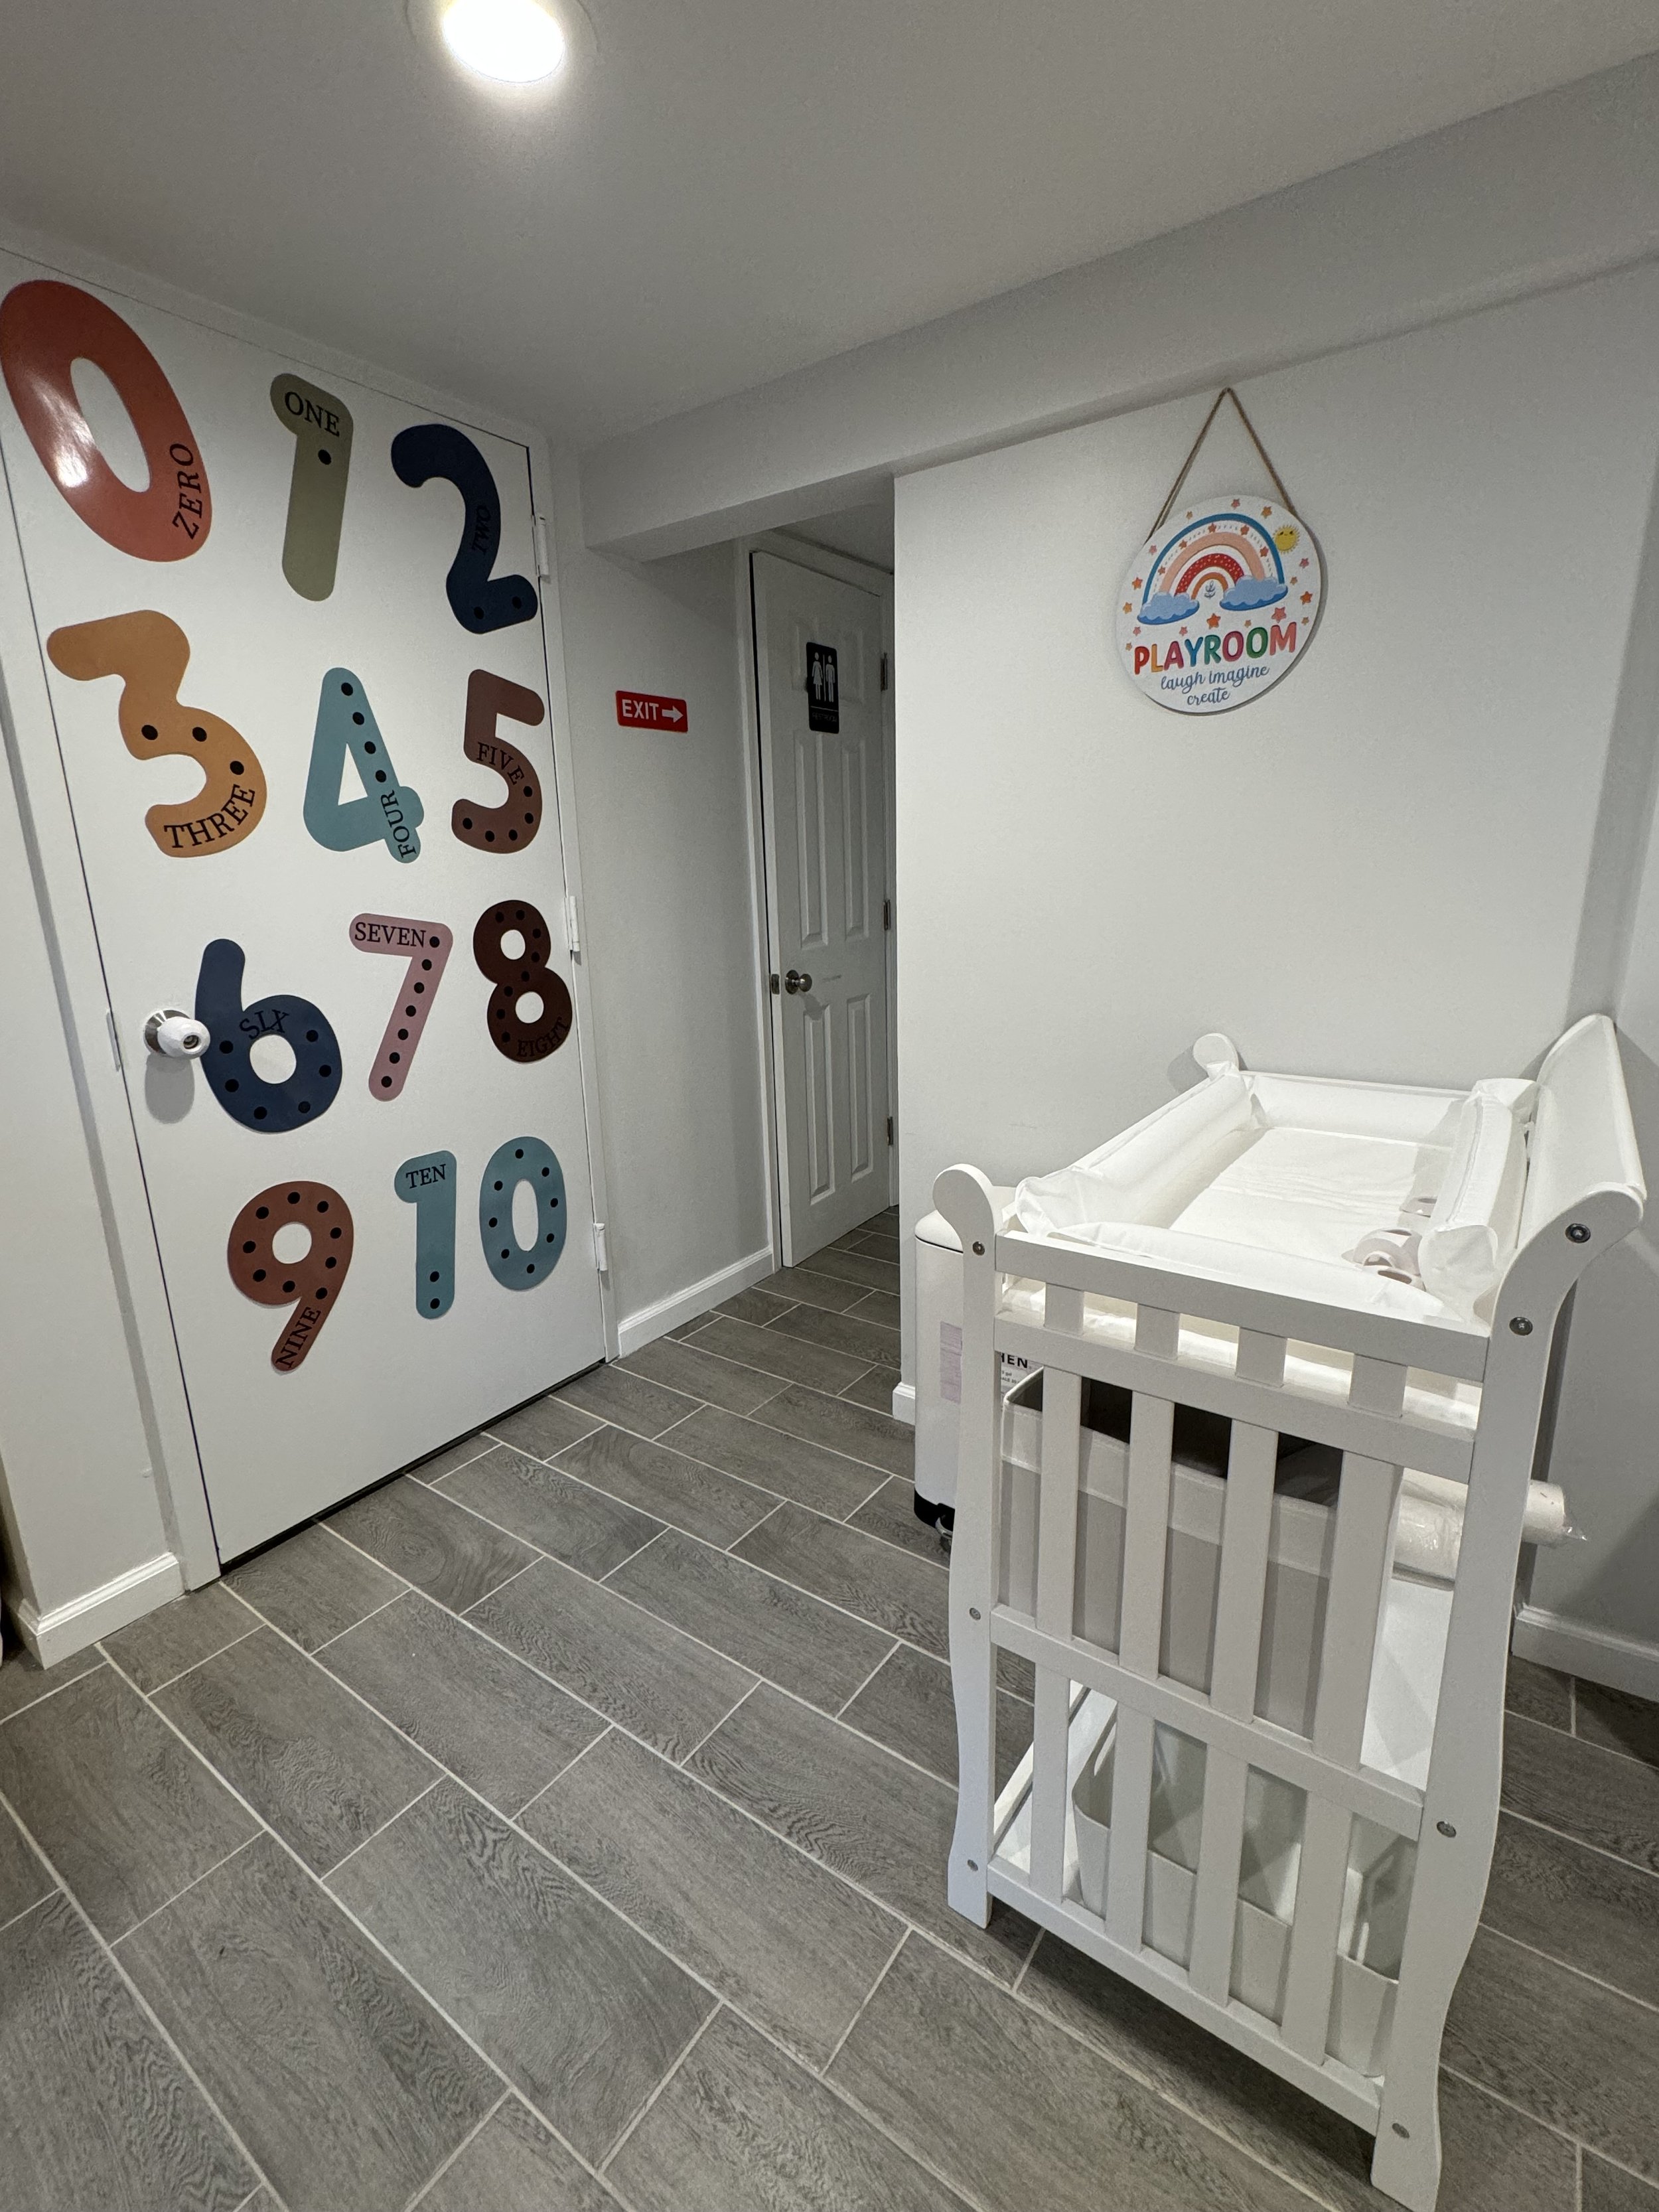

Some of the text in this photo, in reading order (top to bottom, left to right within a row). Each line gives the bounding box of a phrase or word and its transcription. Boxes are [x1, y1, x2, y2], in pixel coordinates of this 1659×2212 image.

[0, 280, 212, 562] 0
[284, 392, 340, 438] ONE
[169, 443, 204, 540] ZERO
[270, 373, 354, 602] 1
[391, 424, 538, 634] 2
[471, 505, 492, 555] TWO
[1134, 622, 1297, 675] PLAYROOM
[1161, 666, 1270, 694] laugh imagine
[621, 699, 660, 721] EXIT
[1187, 687, 1231, 705] create
[46, 609, 267, 857] 3
[303, 668, 424, 863] 4
[451, 669, 545, 853] 5
[476, 743, 524, 786] FIVE
[163, 784, 257, 849] THREE
[380, 790, 417, 859] FOUR
[354, 921, 427, 948] SEVEN
[349, 913, 453, 1102] 7
[473, 900, 573, 1063] 8
[194, 939, 342, 1134] 6
[239, 1009, 290, 1040] SIX
[517, 1015, 569, 1057] EIGHT
[405, 1163, 447, 1189] TEN
[394, 1136, 567, 1320] 10
[228, 1181, 354, 1372] 9
[276, 1306, 322, 1368] NINE
